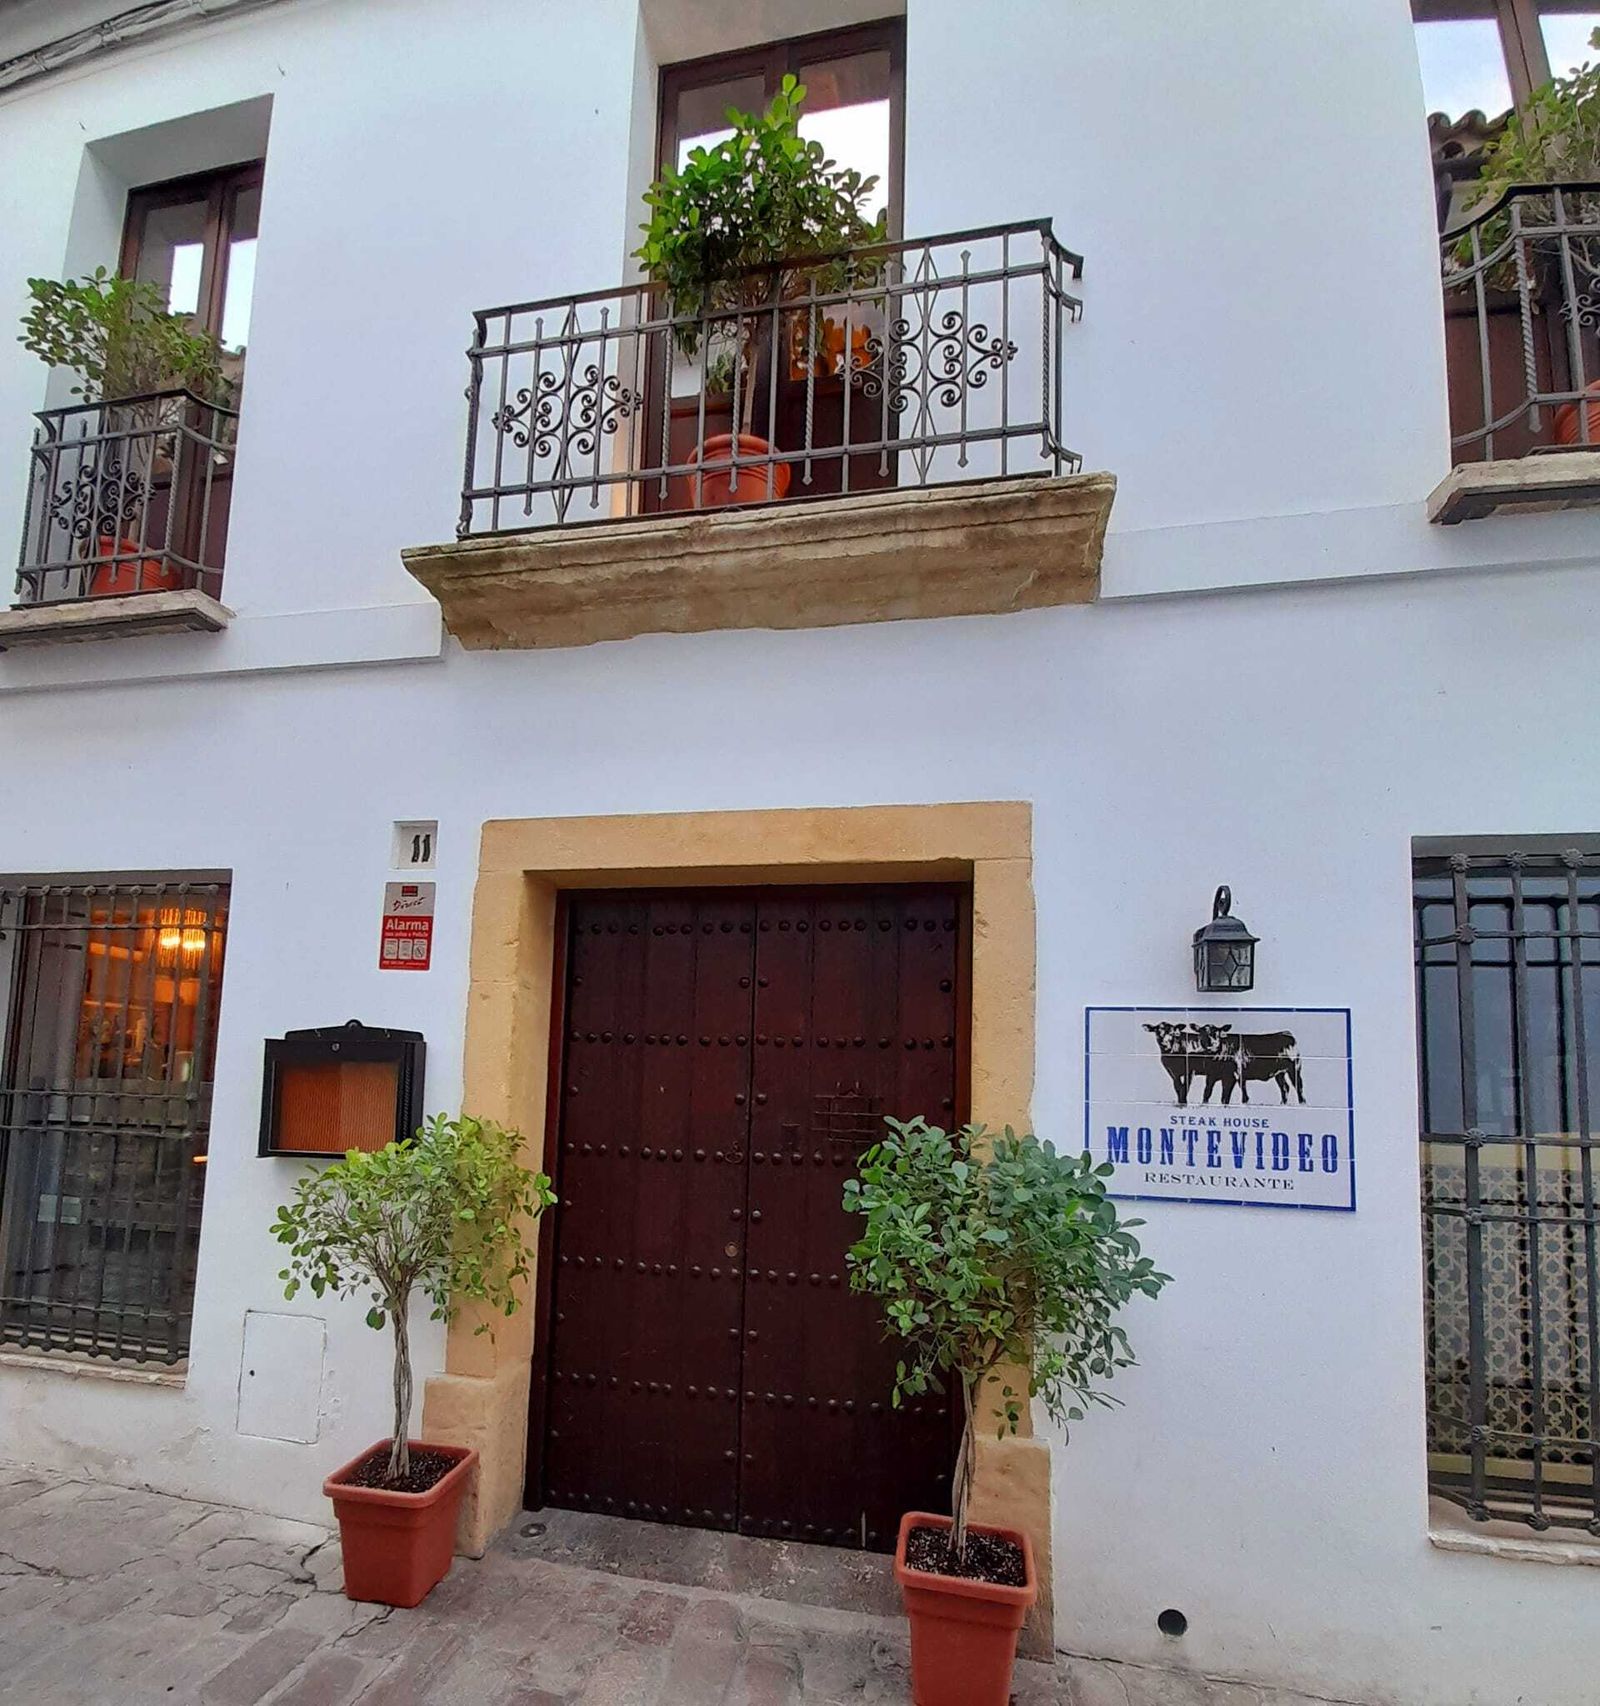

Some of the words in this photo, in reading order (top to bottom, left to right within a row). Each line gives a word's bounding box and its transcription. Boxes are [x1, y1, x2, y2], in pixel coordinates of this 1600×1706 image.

[411, 834, 431, 863] 11
[386, 917, 429, 930] Alarma
[1170, 1115, 1217, 1127] STEAK
[1223, 1117, 1270, 1129] HOUSE
[1106, 1126, 1339, 1174] MONTEVIDEO
[1144, 1171, 1295, 1191] RESTAURANTE
